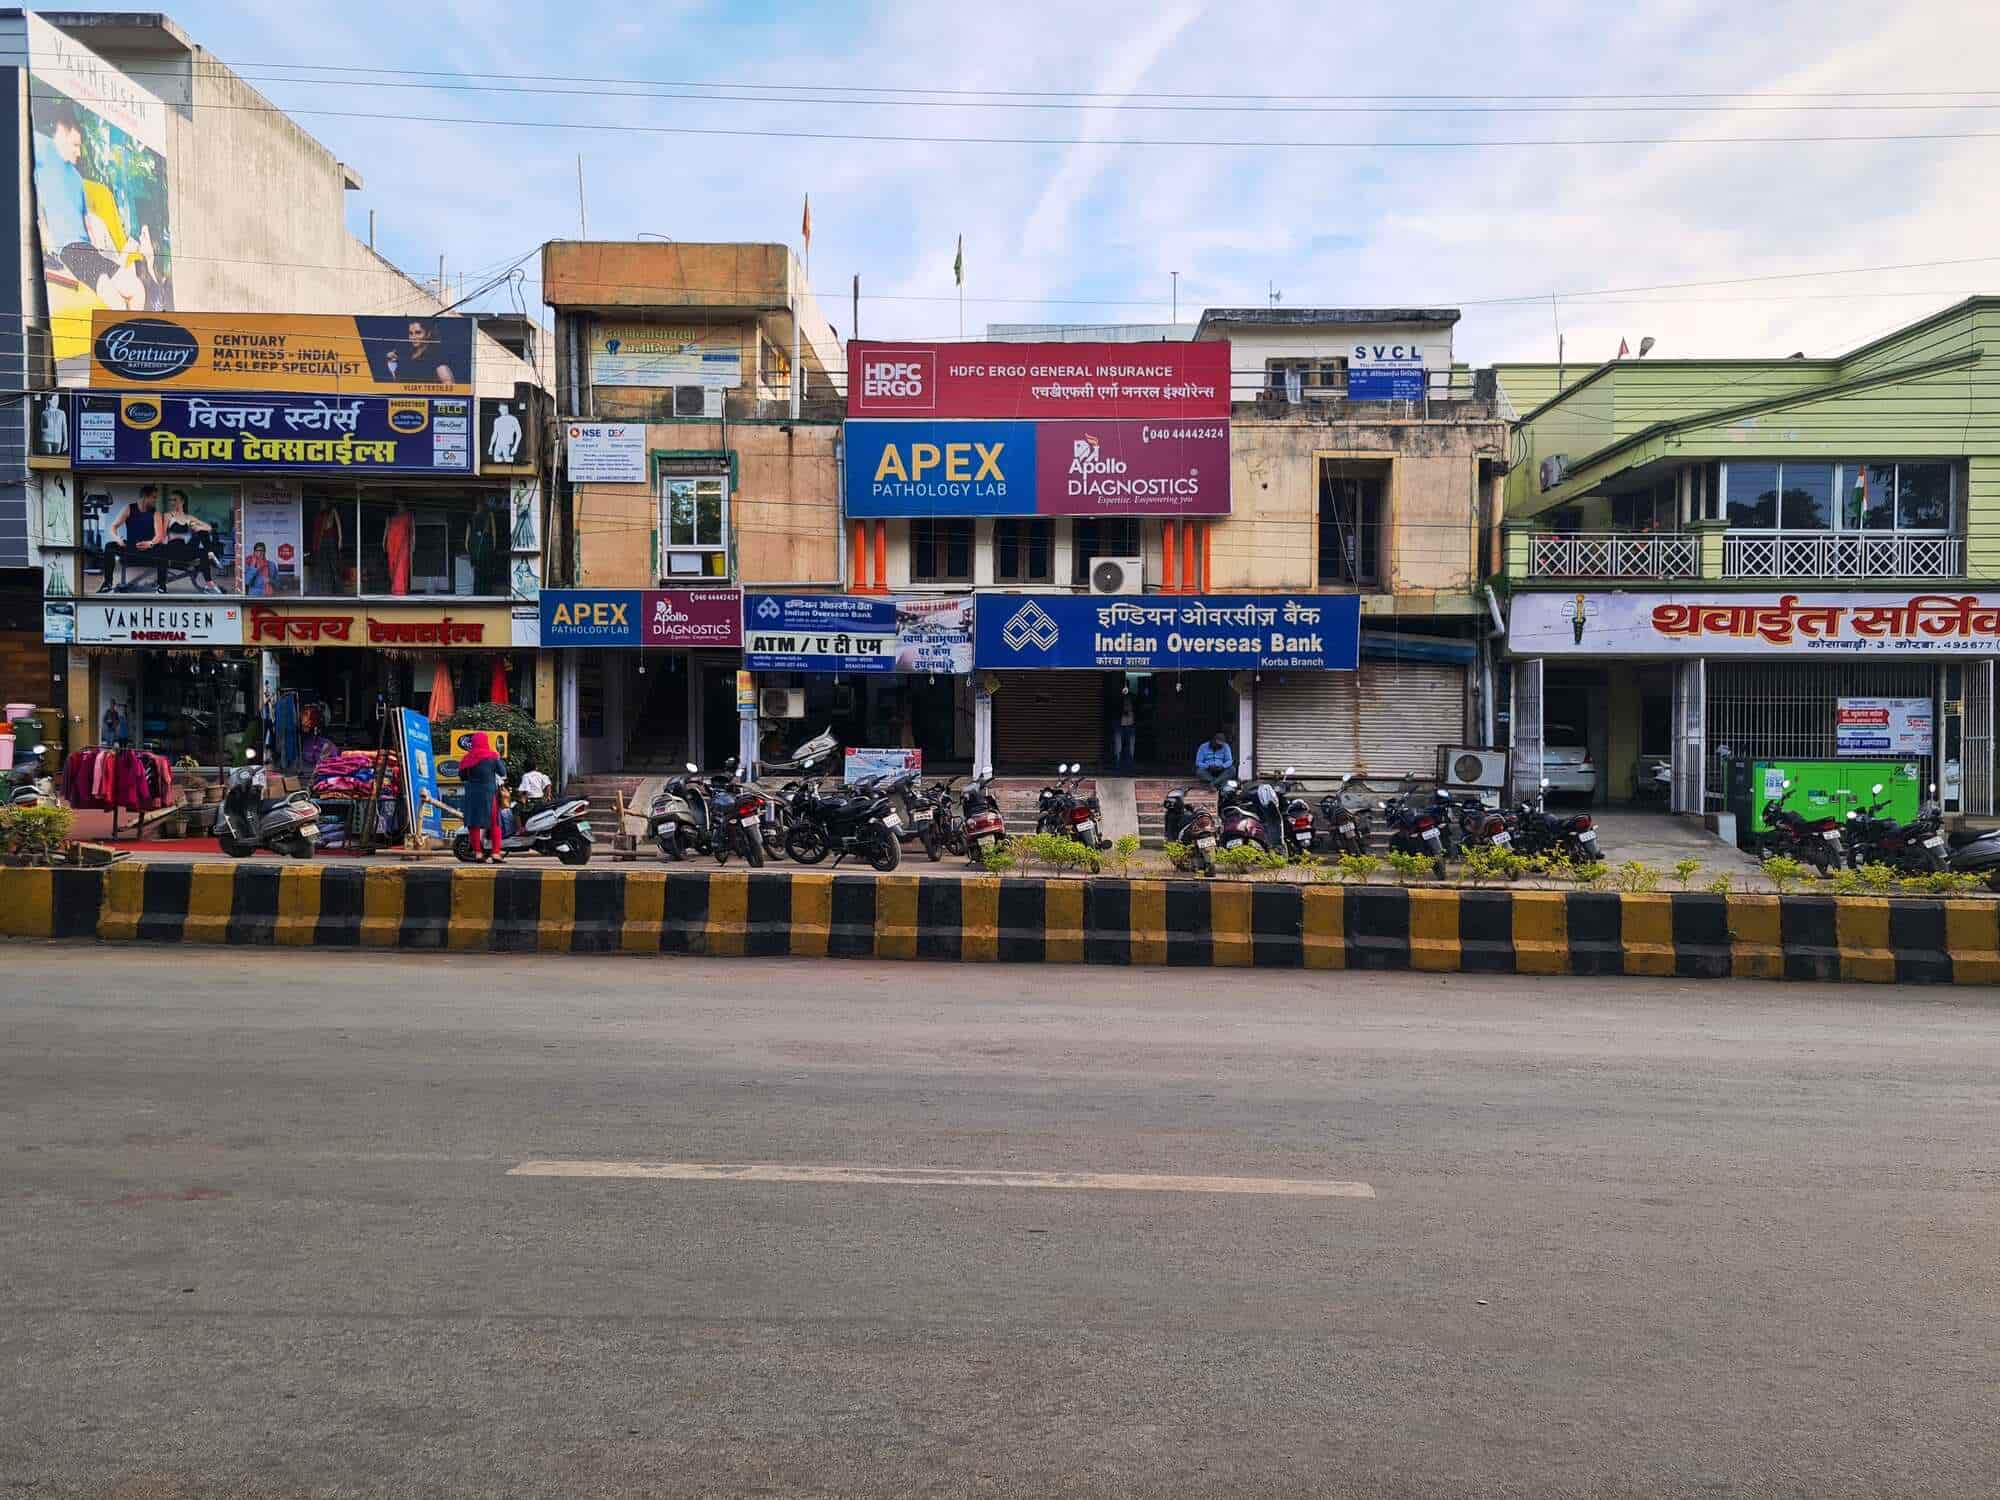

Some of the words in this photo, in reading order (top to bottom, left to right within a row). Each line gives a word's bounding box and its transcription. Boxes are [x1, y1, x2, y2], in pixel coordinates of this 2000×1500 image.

[213, 334, 286, 346] CENTUARY
[105, 329, 190, 371] Centuary
[213, 348, 285, 360] MATTRESS
[212, 360, 232, 372] KA
[235, 361, 278, 373] SLEEP
[281, 363, 360, 374] SPECIALIST
[864, 363, 922, 380] HDFC
[950, 366, 985, 377] HDFC
[988, 366, 1027, 377] ERGO
[1030, 366, 1093, 377] GENERAL
[1096, 366, 1173, 377] INSURANCE
[864, 380, 922, 397] ERGO
[1032, 383, 1094, 399] एचडीएफसी
[1097, 383, 1119, 399] एर्गो
[1121, 386, 1160, 399] जनरल
[187, 399, 274, 429] विजय
[284, 399, 364, 432] स्टोर्स
[582, 428, 600, 437] NSE
[1150, 429, 1170, 440] 040
[1172, 428, 1224, 440] 44442424
[150, 431, 235, 461] विजय
[239, 432, 398, 465] टेक्सटाईल्स
[873, 443, 1006, 482] APEX
[1068, 457, 1127, 475] Apollo
[872, 483, 971, 497] PATHOLOGY
[976, 483, 1007, 497] LAB
[1067, 479, 1199, 496] DIAGNOSTICS
[551, 603, 629, 625] APEX
[653, 612, 689, 623] Apollo
[1097, 602, 1177, 628] इण्डियन
[1180, 602, 1277, 628] ओवरसीज़
[1282, 600, 1321, 626] बैंक
[1651, 595, 1849, 646] थवाईत
[250, 607, 354, 642] विजय
[551, 625, 608, 635] PATHOLOGY
[610, 625, 630, 634] LAB
[653, 624, 732, 636] DIAGNOSTICS
[752, 637, 795, 652] ATM
[816, 638, 829, 653] ए
[834, 634, 854, 655] टी
[856, 638, 882, 655] एम
[1095, 633, 1157, 652] Indian
[1167, 633, 1262, 652] Overseas
[1270, 633, 1323, 652] Bank
[1261, 657, 1289, 667] Korba
[1291, 657, 1324, 667] Branch
